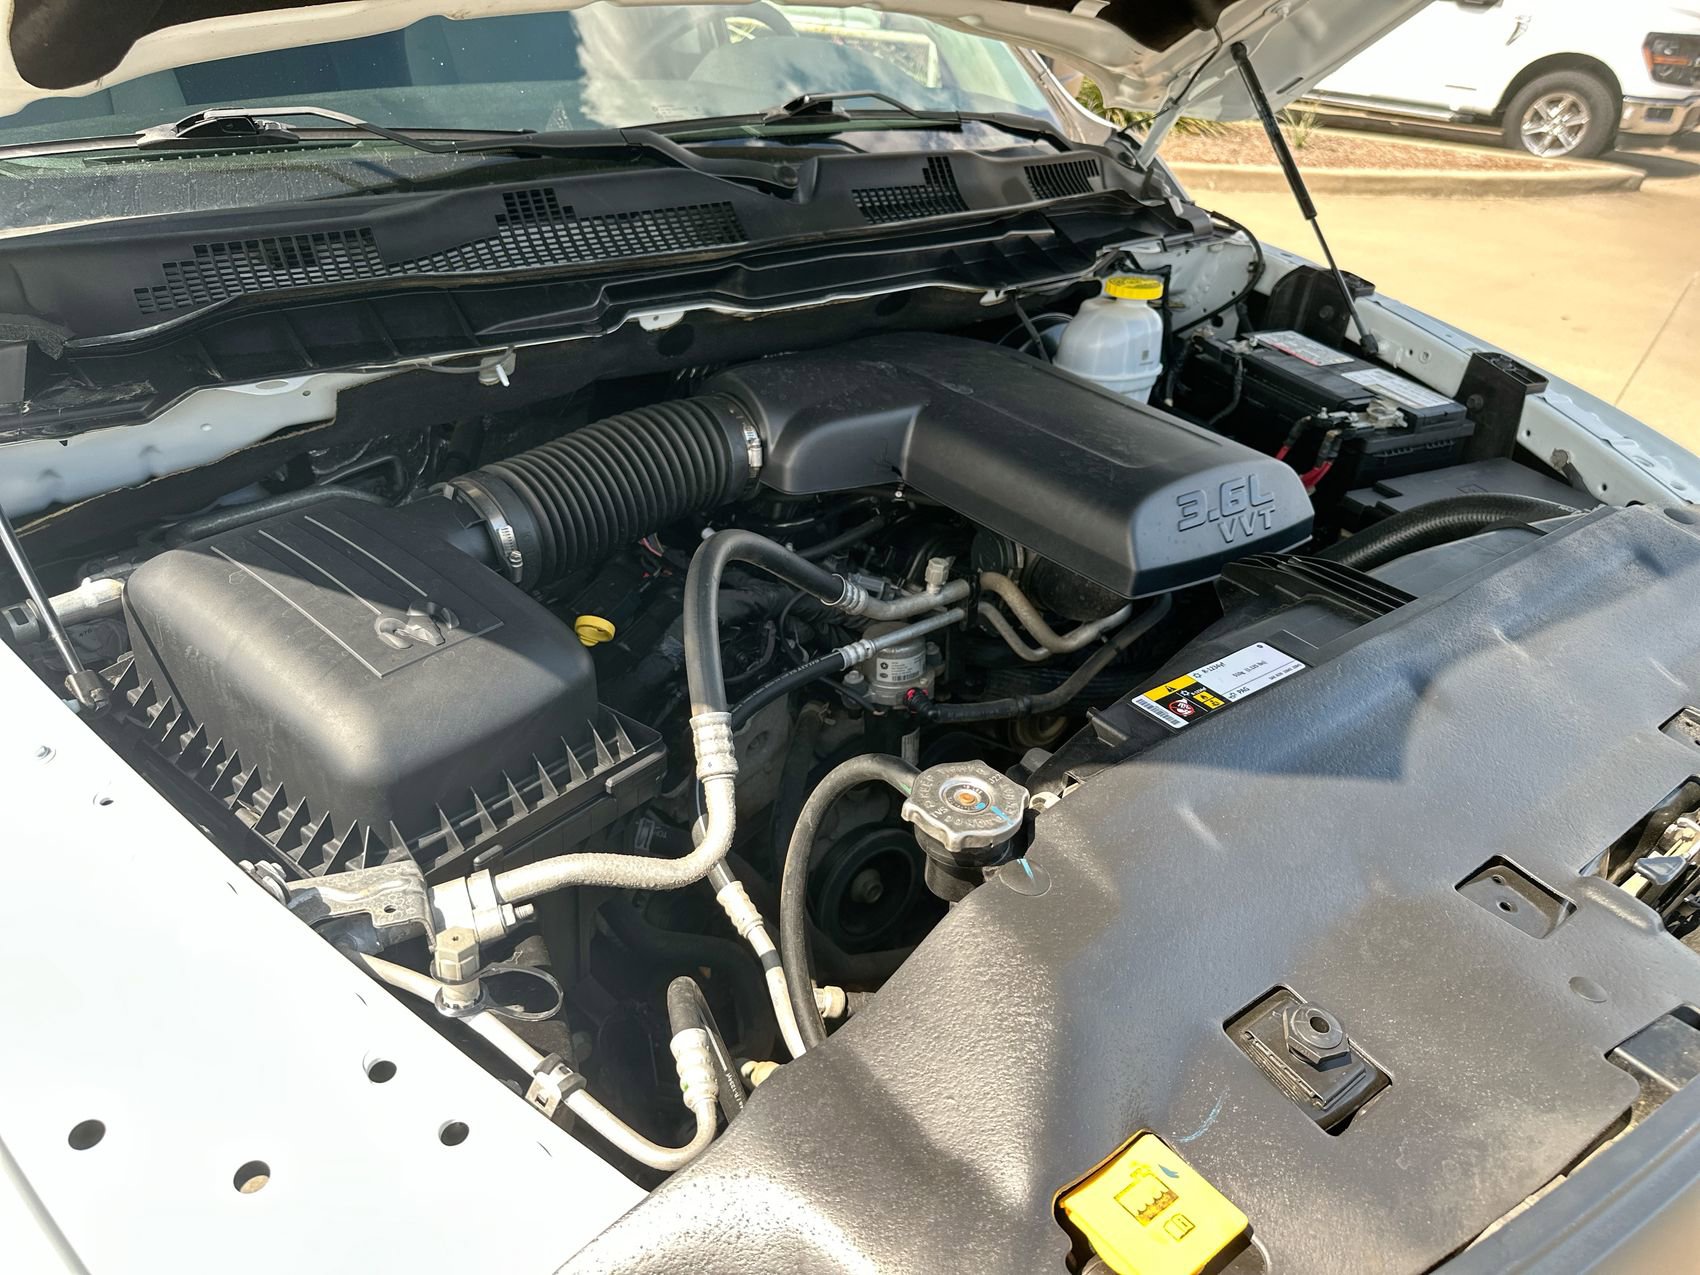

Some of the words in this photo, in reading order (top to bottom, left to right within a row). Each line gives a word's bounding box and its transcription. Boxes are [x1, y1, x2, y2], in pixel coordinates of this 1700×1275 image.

[1176, 473, 1274, 532] 3.6L
[1218, 505, 1275, 543] VVT
[1201, 661, 1226, 674] R-1234yf
[1238, 686, 1250, 695] PAG
